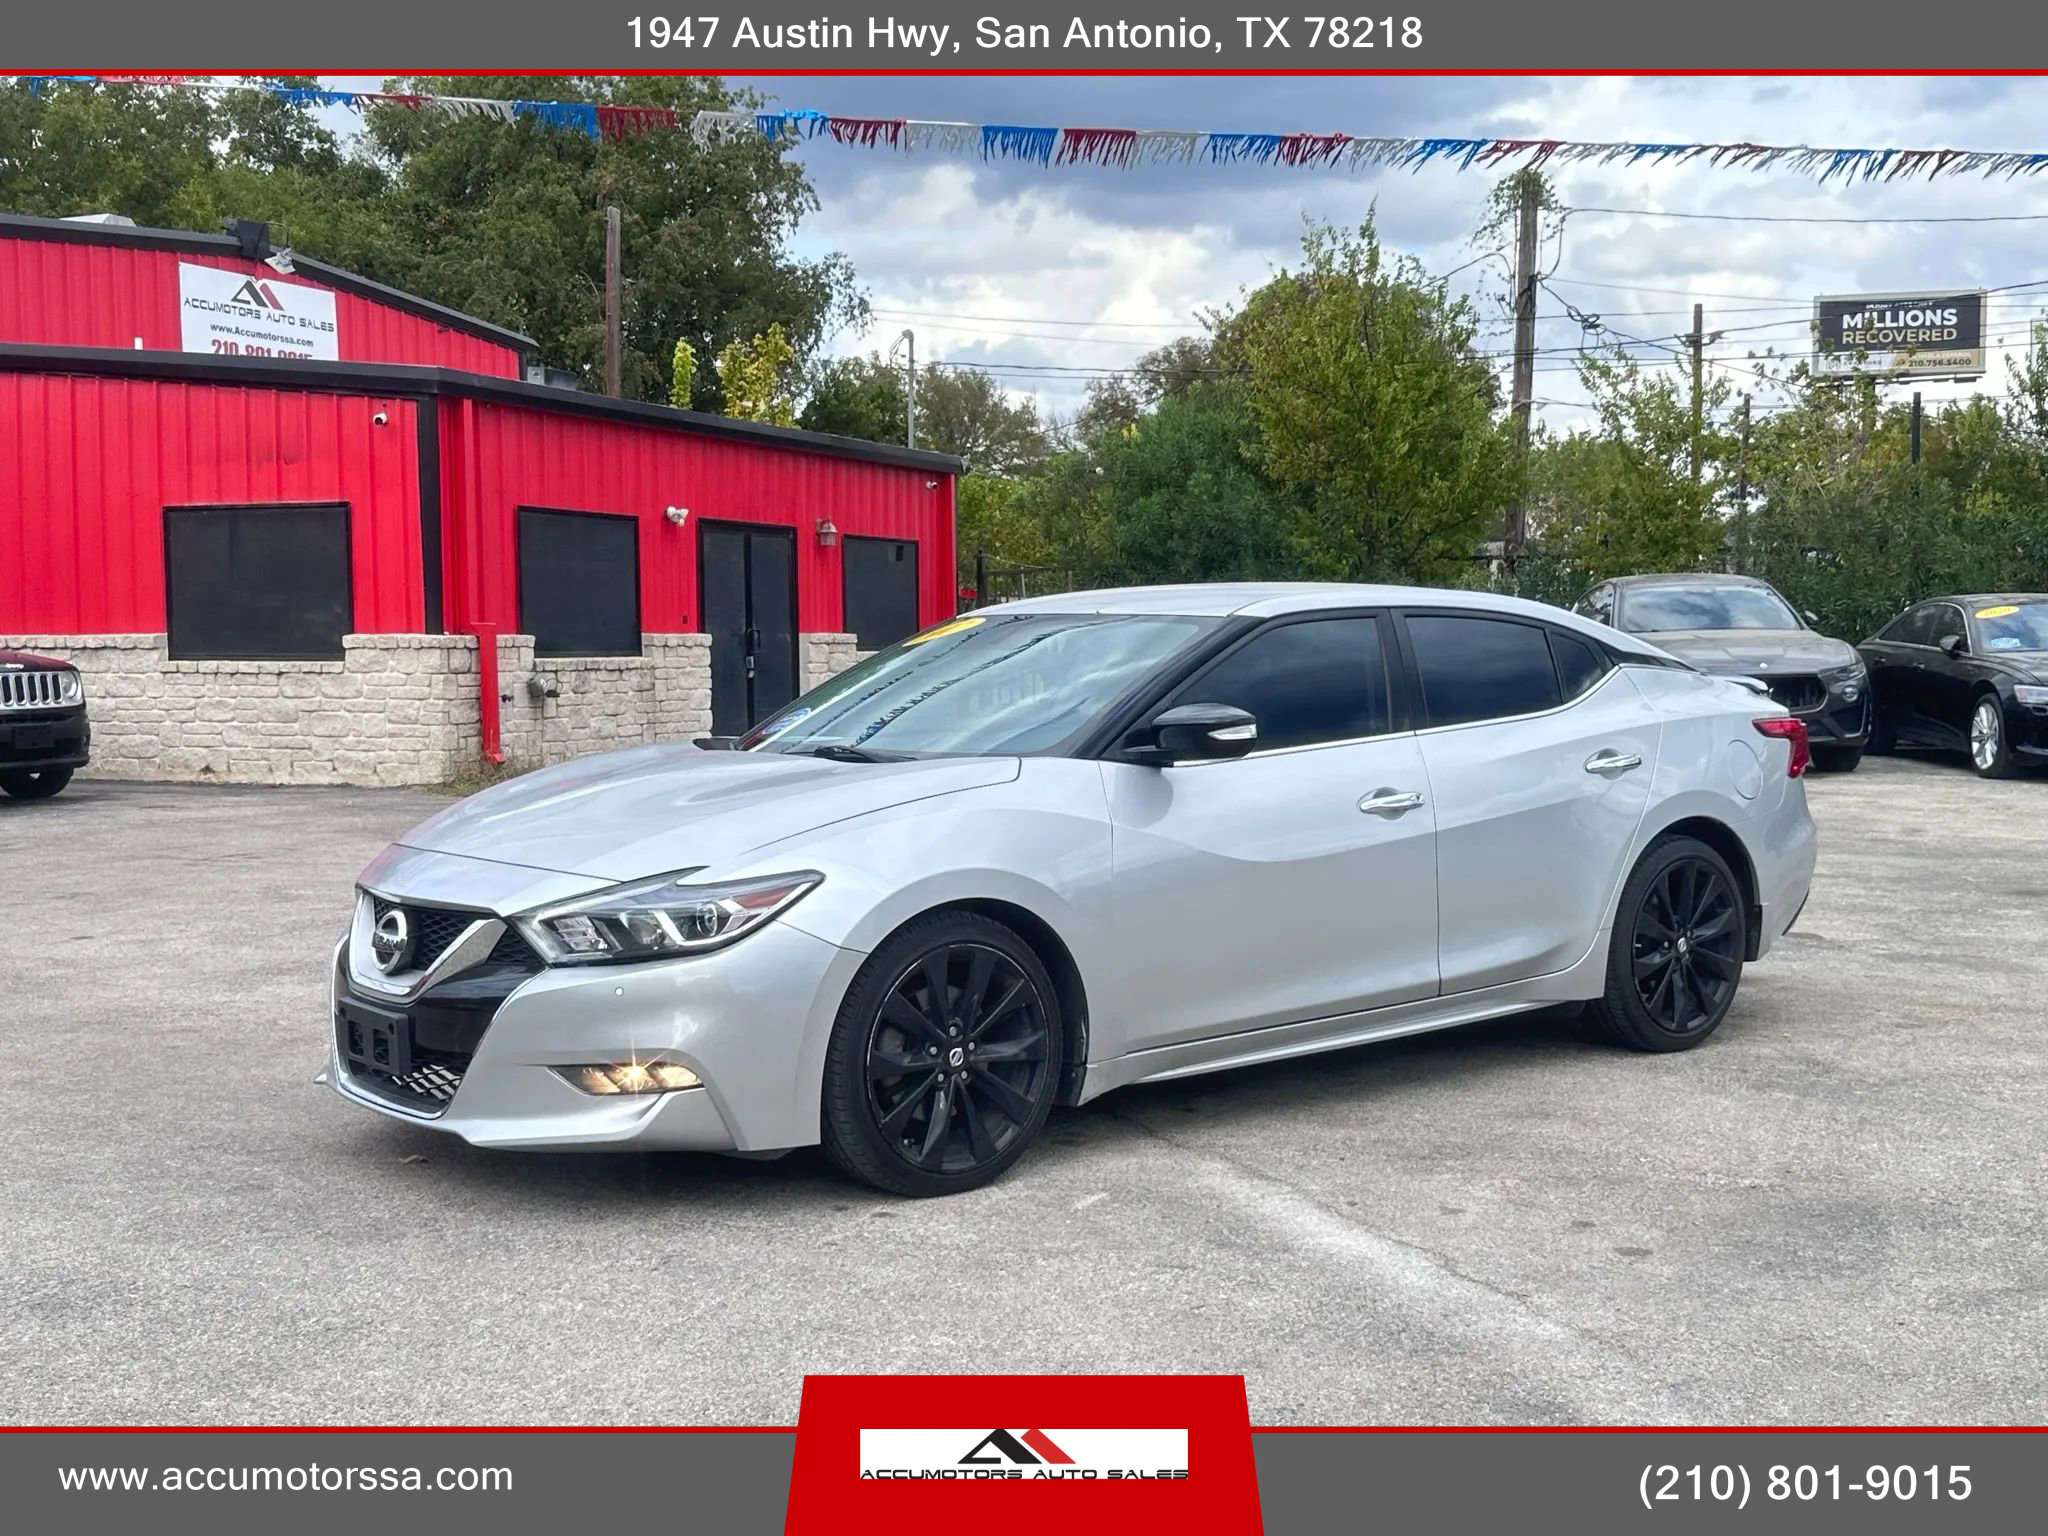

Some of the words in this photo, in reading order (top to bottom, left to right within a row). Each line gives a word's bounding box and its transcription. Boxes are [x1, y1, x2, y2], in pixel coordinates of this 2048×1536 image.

[184, 297, 261, 320] ACCUMOTORS
[266, 311, 295, 326] AUTO
[299, 317, 335, 332] SALES
[210, 323, 314, 347] www.Accumotorssa.com
[1842, 328, 1957, 345] RECOVERED
